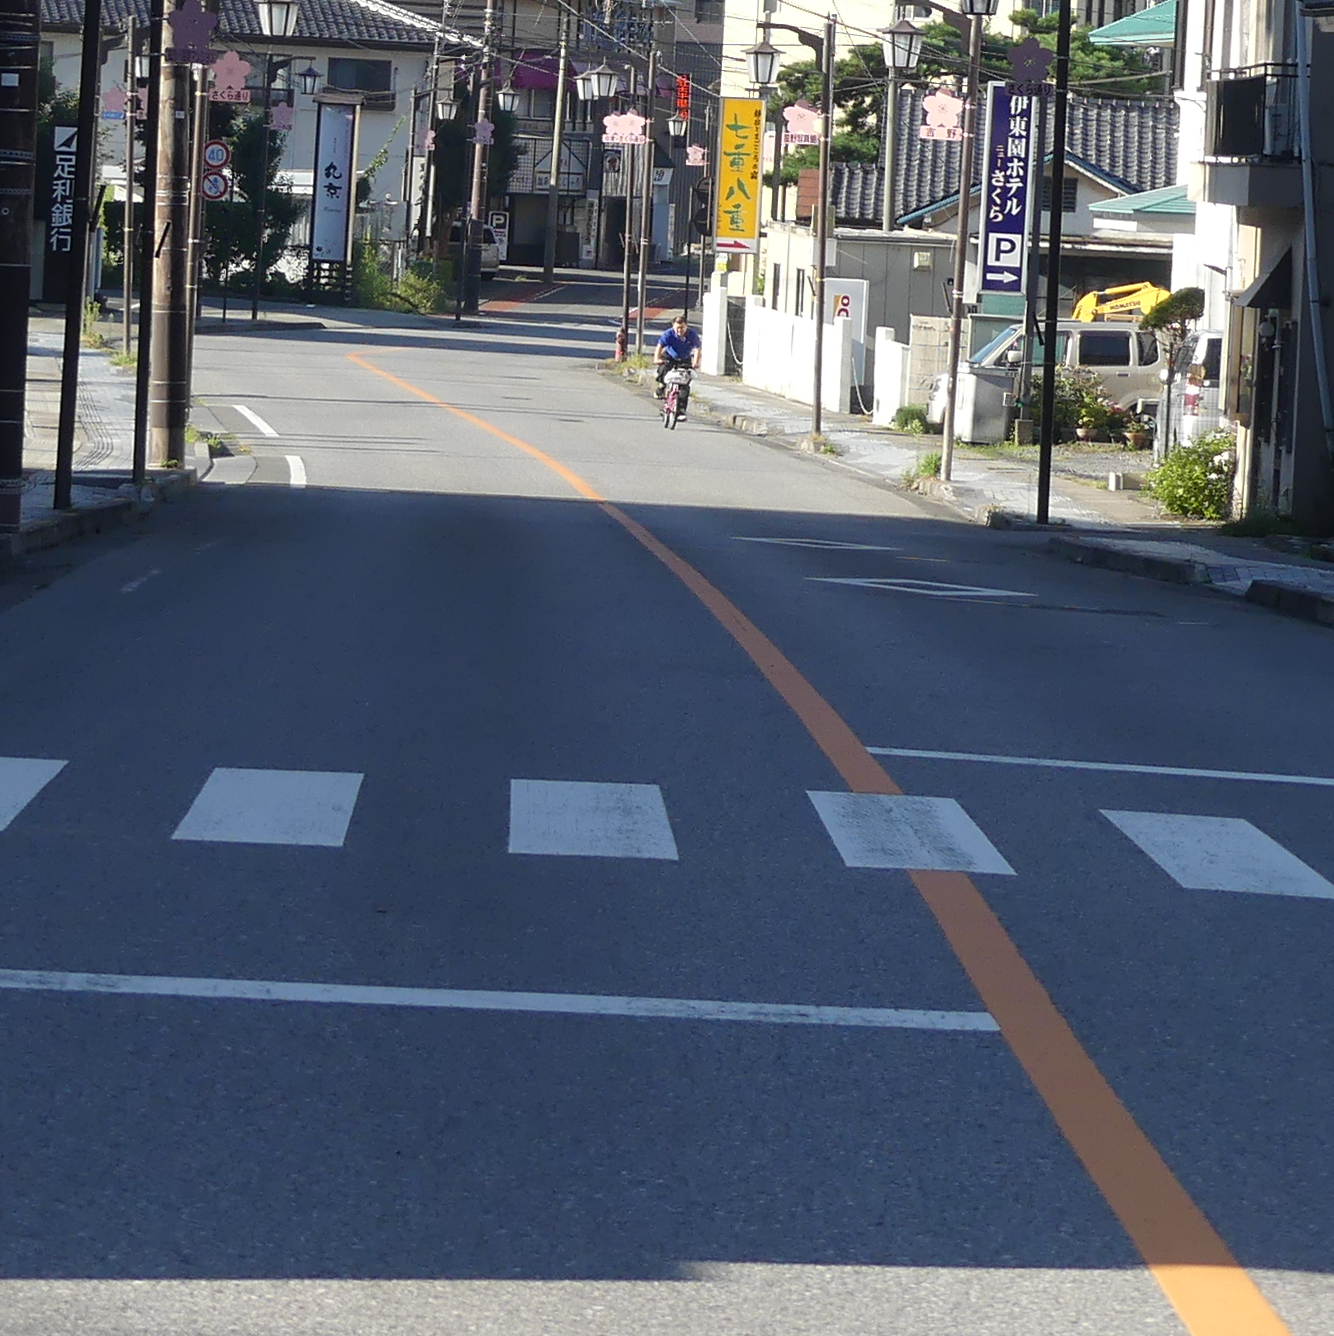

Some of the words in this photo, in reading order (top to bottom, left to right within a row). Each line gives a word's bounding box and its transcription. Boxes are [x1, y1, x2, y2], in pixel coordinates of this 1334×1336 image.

[212, 90, 249, 101] さくら通り
[208, 148, 224, 161] 40
[1004, 96, 1028, 216] 伊東園ホテル
[989, 145, 1005, 222] ニューさくら
[50, 155, 76, 251] 足利銀行
[492, 215, 504, 227] P
[995, 237, 1016, 262] P
[1110, 300, 1141, 310] KOMATSU
